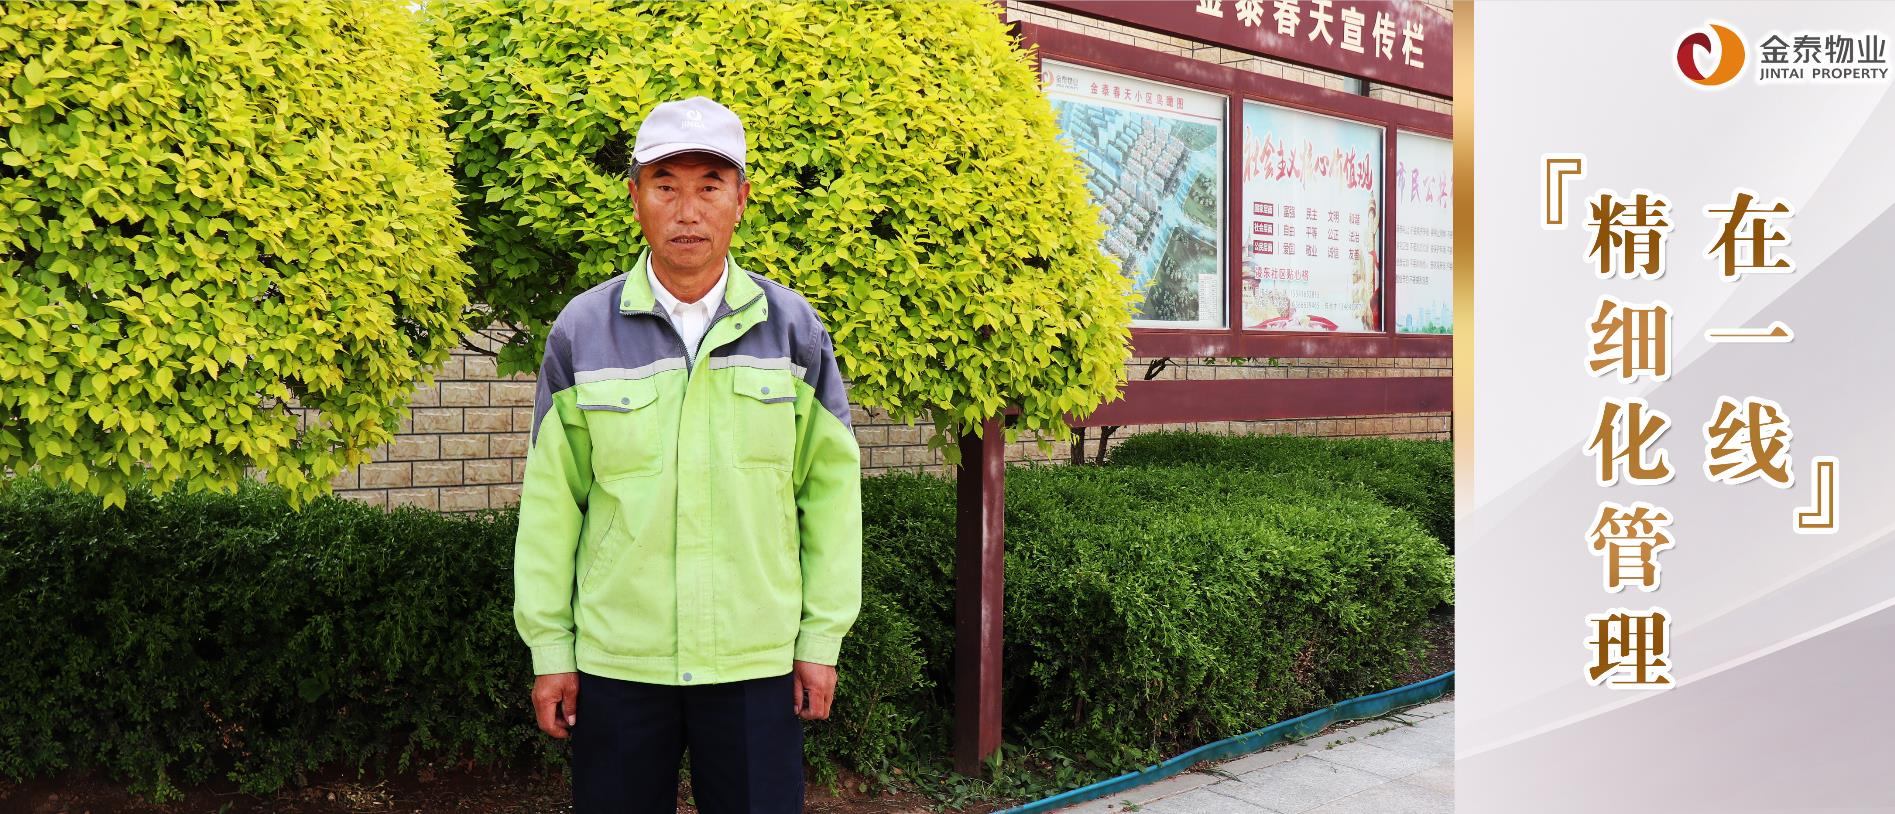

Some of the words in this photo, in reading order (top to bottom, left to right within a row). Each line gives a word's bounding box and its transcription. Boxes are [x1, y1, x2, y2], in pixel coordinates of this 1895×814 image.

[1090, 82, 1184, 110] 金泰春天小区鸟瞰图
[1243, 126, 1374, 191] 社会主义核心价值观
